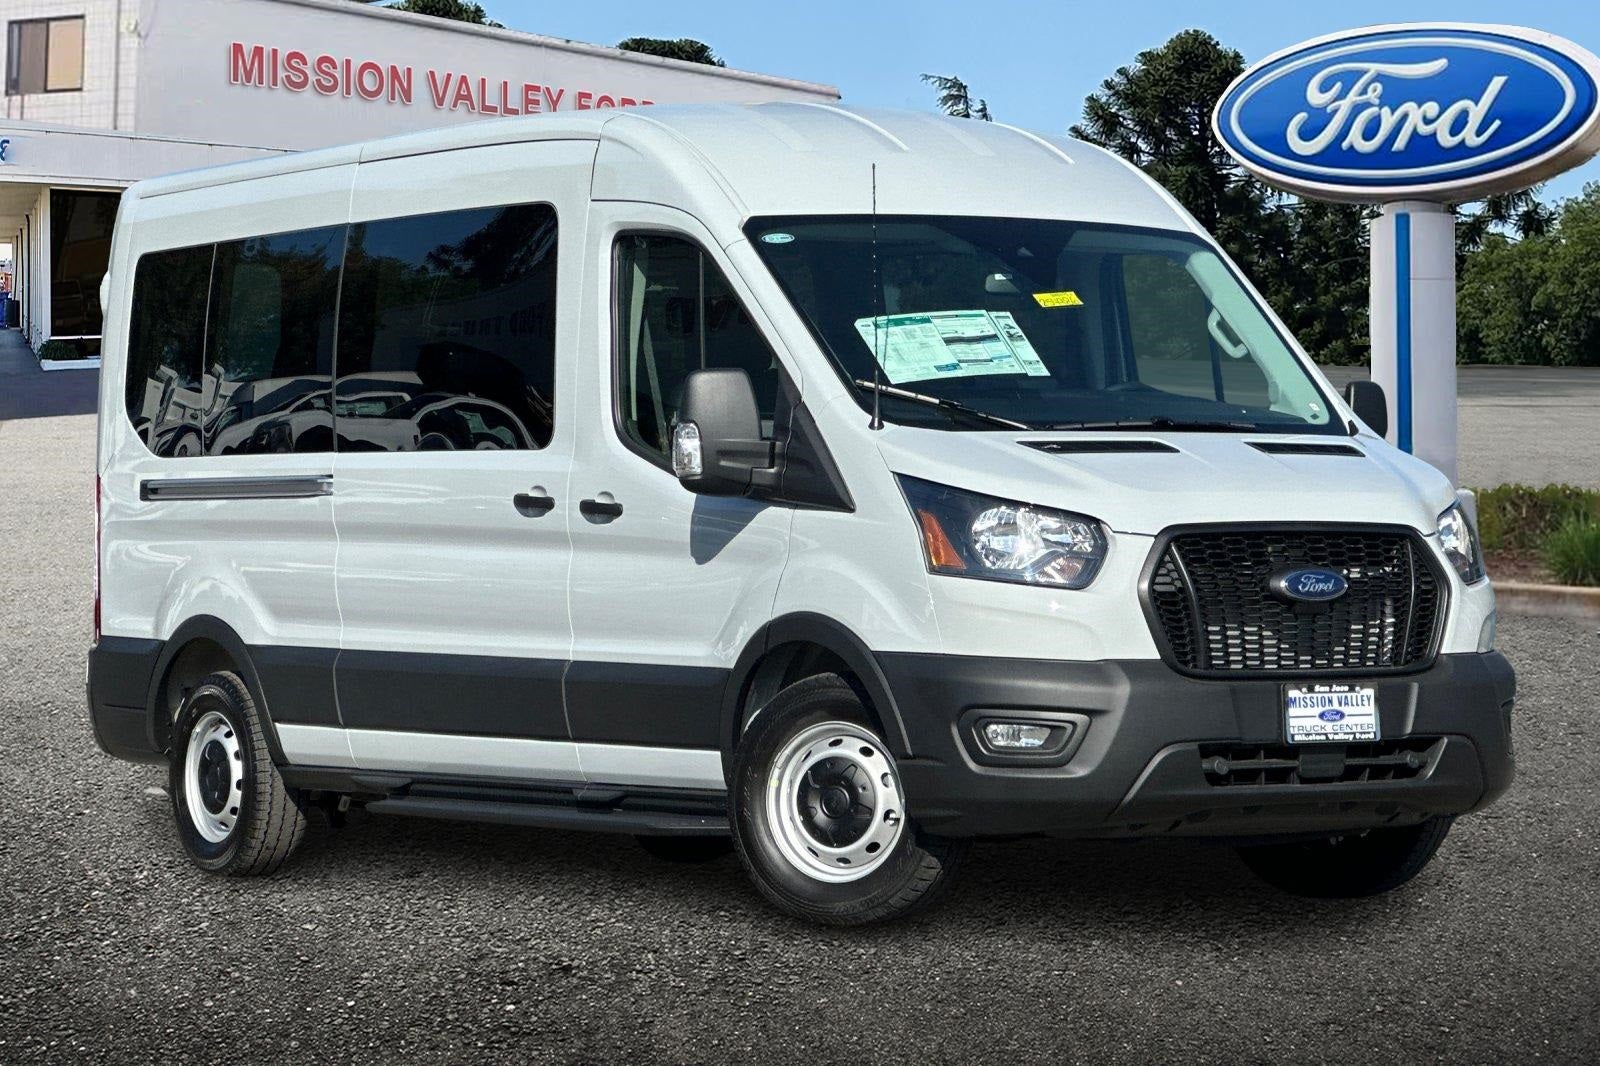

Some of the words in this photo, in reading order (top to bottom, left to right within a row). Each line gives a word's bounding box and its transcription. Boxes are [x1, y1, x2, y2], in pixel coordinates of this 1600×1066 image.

[230, 41, 413, 104] MISSION
[427, 69, 565, 117] VALLEY
[1286, 57, 1509, 156] Ford
[1298, 574, 1335, 593] Ford
[1286, 695, 1334, 709] MISSION
[1337, 694, 1371, 707] VALLEY
[1322, 711, 1341, 721] Ford
[1290, 724, 1326, 733] TRUCK
[1332, 723, 1374, 732] CENTER
[1327, 733, 1354, 741] Valley
